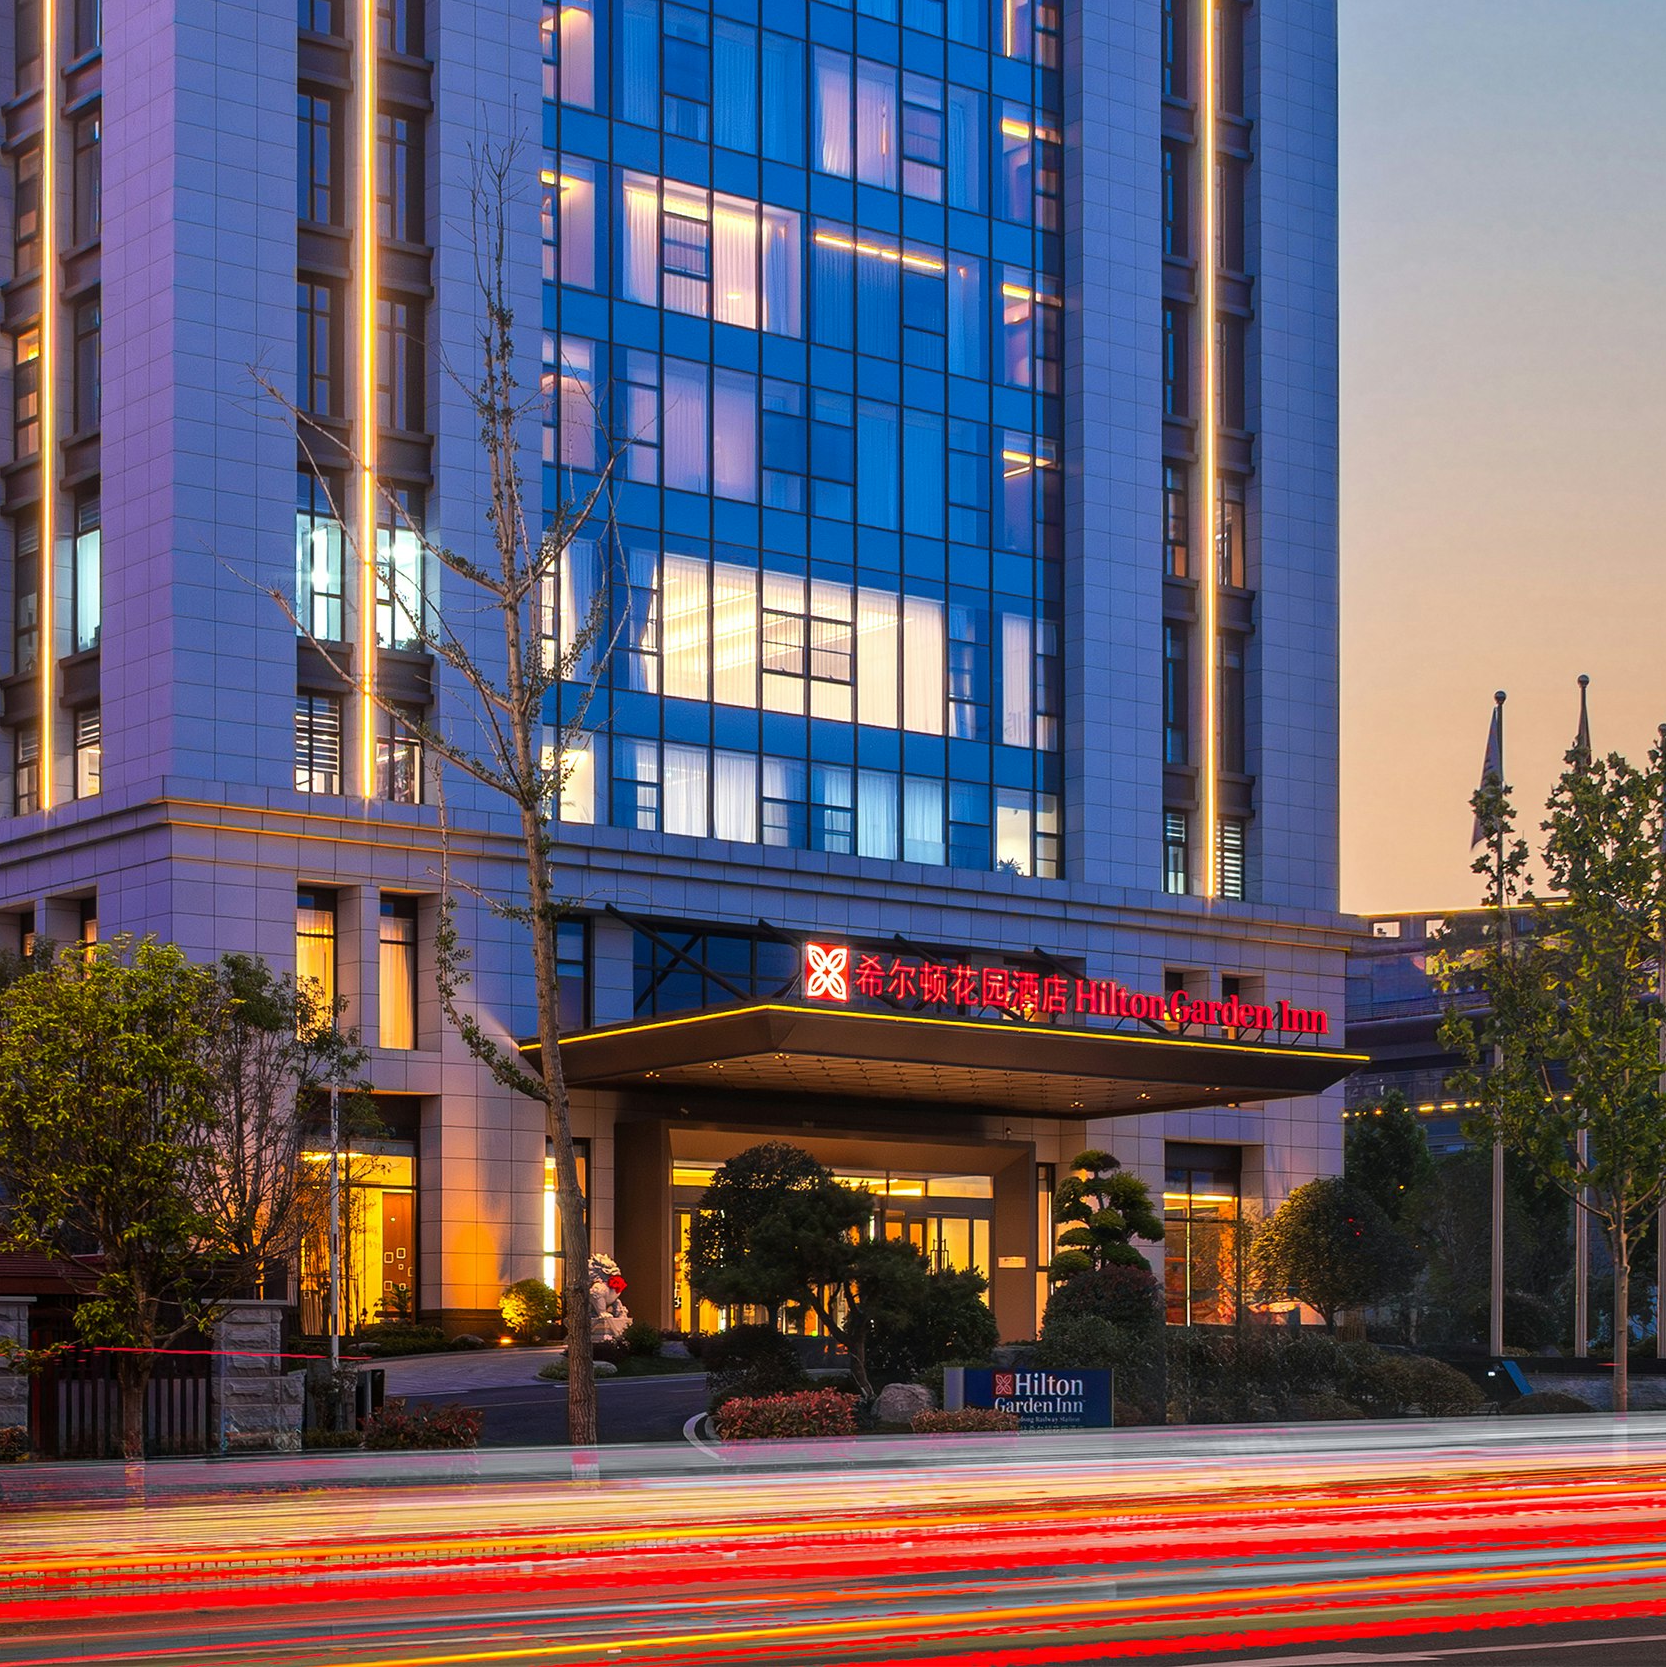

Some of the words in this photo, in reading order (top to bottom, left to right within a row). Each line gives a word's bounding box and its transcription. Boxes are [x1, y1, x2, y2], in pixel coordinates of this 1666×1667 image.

[855, 954, 1068, 1014] 希尔顿花园酒店
[1075, 979, 1166, 1020] Hilton
[1170, 989, 1274, 1030] Garden
[1278, 999, 1329, 1034] Inn
[1015, 1373, 1083, 1396] Hilton
[994, 1397, 1053, 1414] Garden
[1056, 1397, 1084, 1413] Inn
